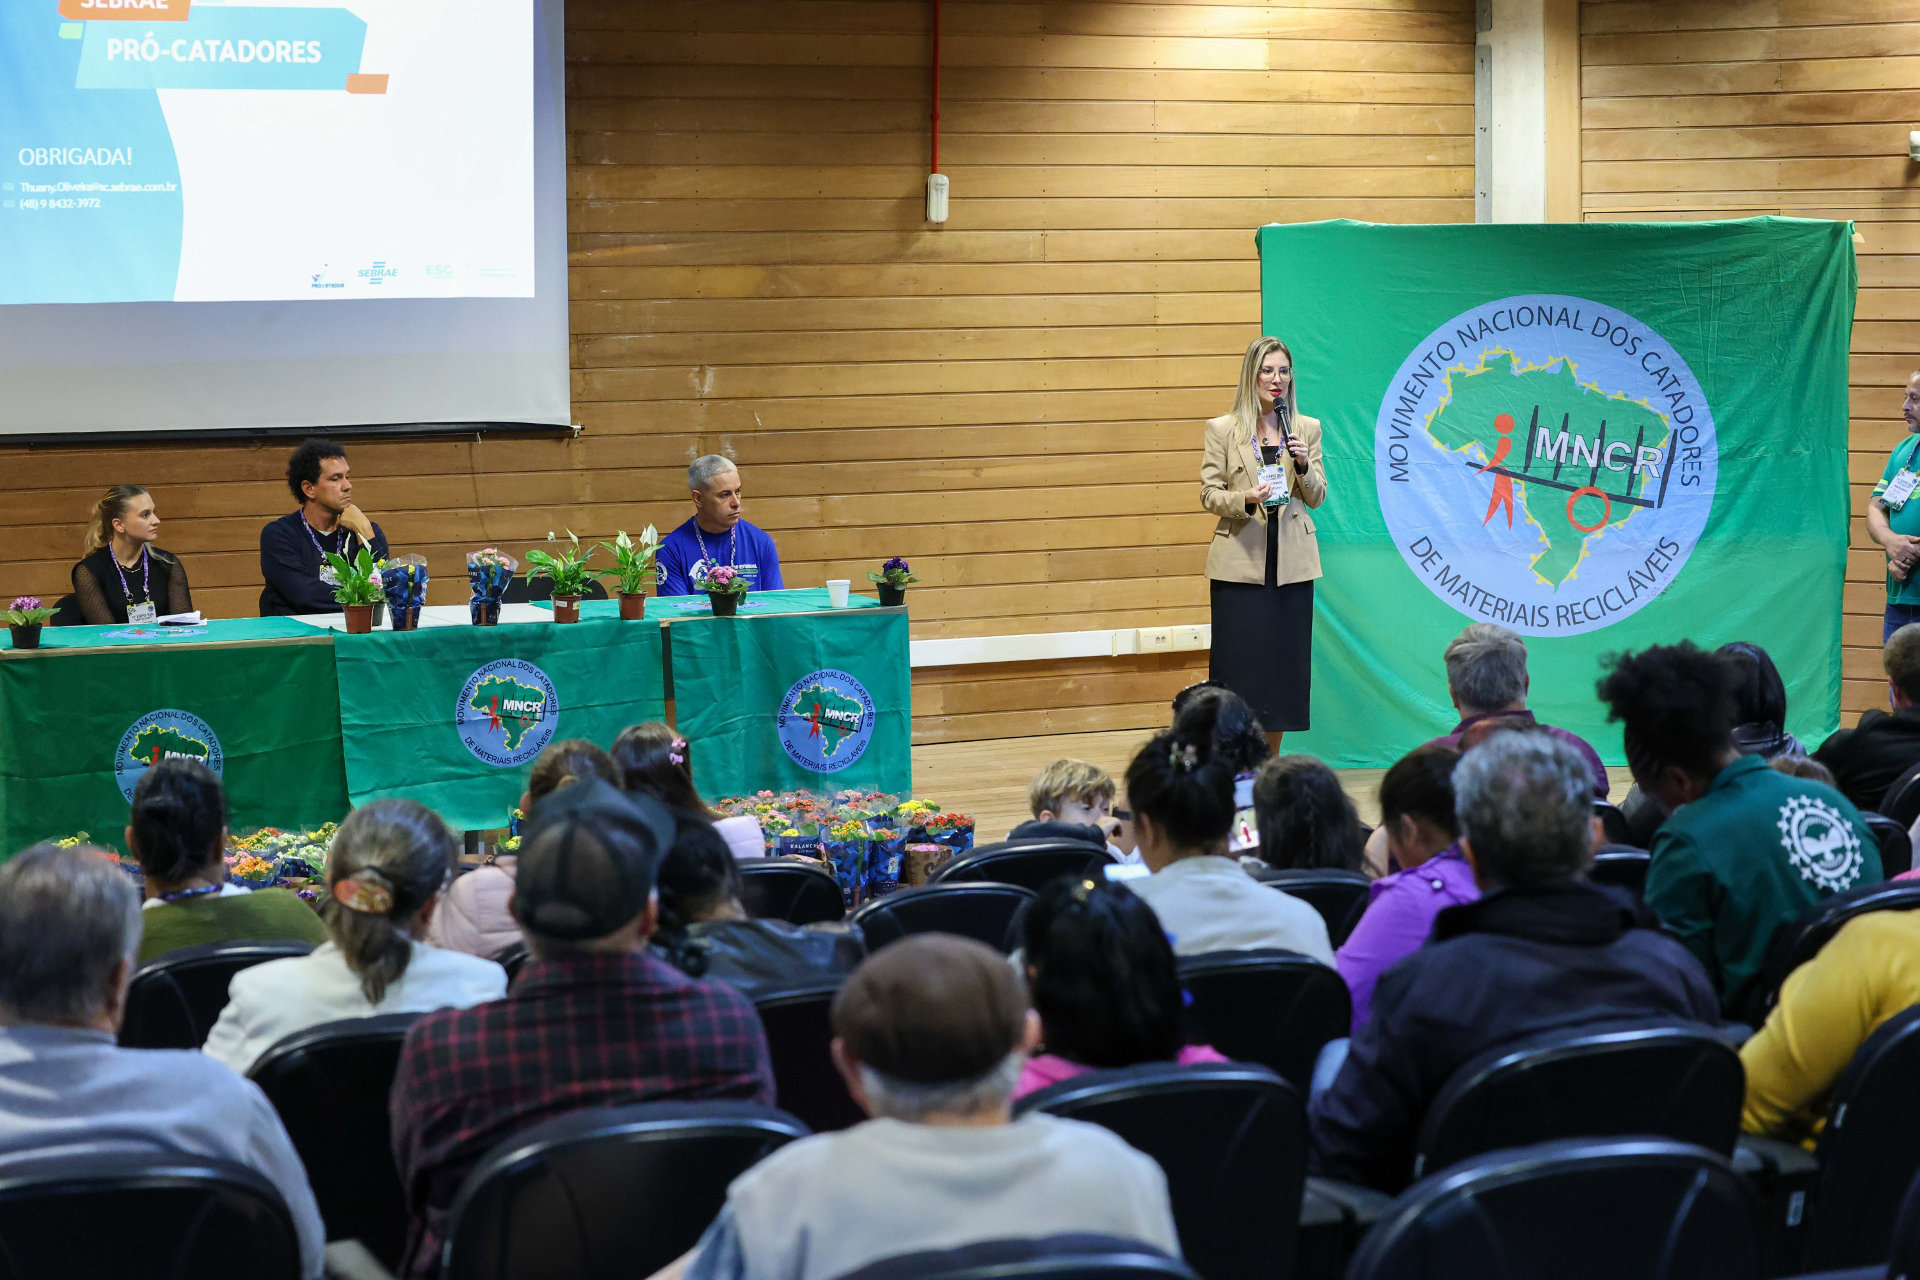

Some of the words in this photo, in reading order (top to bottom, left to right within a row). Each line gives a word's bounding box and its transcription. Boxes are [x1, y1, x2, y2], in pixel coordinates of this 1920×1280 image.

[107, 31, 322, 63] PRÓ-CATADORES
[18, 147, 133, 166] OBRIGADA!
[40, 199, 46, 208] 9
[358, 268, 399, 277] SEBRAE
[1390, 341, 1456, 482] MOVIMENTO
[1457, 305, 1585, 348] NACIONAL
[1592, 316, 1643, 356] DOS
[1641, 351, 1702, 487] CATADORES
[1535, 426, 1664, 479] MNCR
[1409, 535, 1443, 573] DE
[1441, 564, 1550, 628] MATERIAIS
[1556, 537, 1680, 627] RECICLÁVEIS
[457, 676, 479, 725] MOVIMENTO
[477, 660, 517, 677] NACIONAL
[518, 662, 535, 674] DOS
[534, 671, 557, 716] CATADORES
[503, 699, 541, 712] MNCR
[778, 683, 803, 728] MOVIMENTO
[802, 671, 838, 685] NACIONAL
[839, 673, 855, 686] DOS
[854, 683, 874, 727] CATADORES
[824, 708, 860, 723] MNCR
[116, 725, 140, 776] MOVIMENTO
[138, 711, 179, 727] NACIONAL
[180, 713, 198, 725] DOS
[198, 723, 220, 771] CATADORES
[464, 736, 476, 749] DE
[474, 746, 512, 764] MATERIAIS
[513, 728, 552, 763] RECICLÁVEIS
[784, 739, 794, 752] DE
[791, 750, 827, 770] MATERIAIS
[828, 739, 867, 770] RECICLÁVEIS
